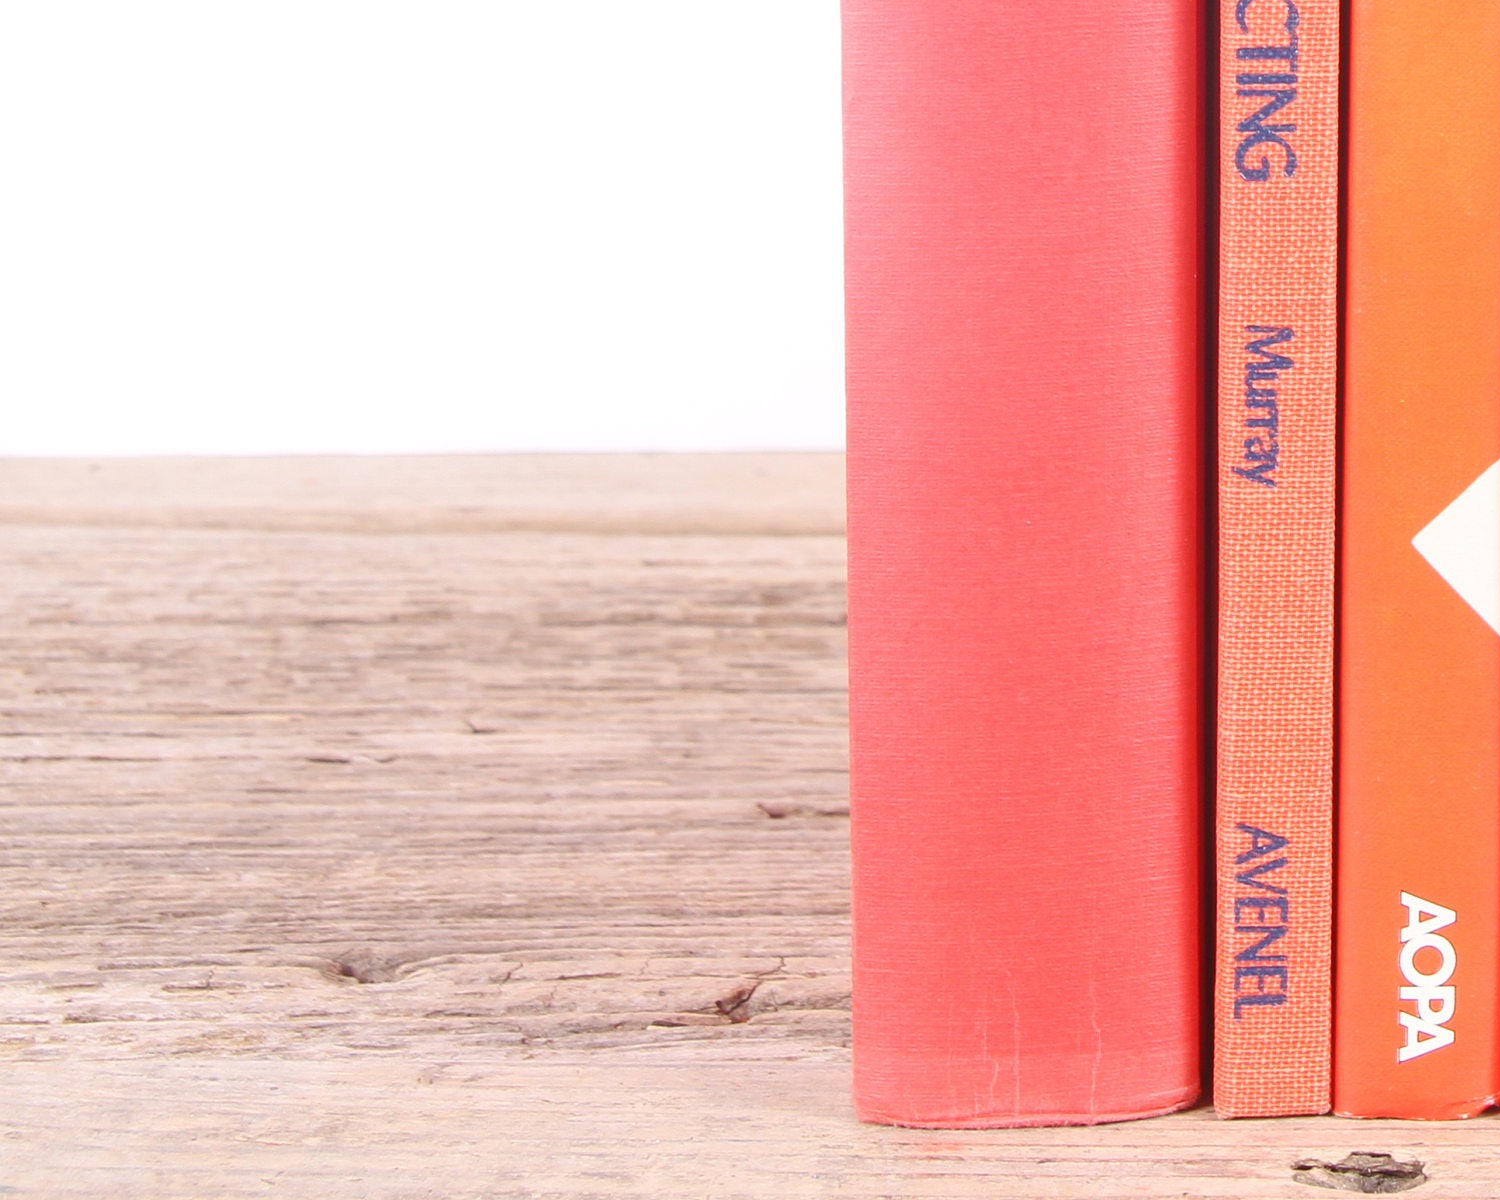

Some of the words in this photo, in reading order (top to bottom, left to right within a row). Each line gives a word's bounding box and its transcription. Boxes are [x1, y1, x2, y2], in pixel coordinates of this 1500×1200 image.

[1232, 325, 1294, 487] Murray
[1234, 823, 1289, 1021] AVENEL
[1397, 889, 1457, 1064] AOPA
